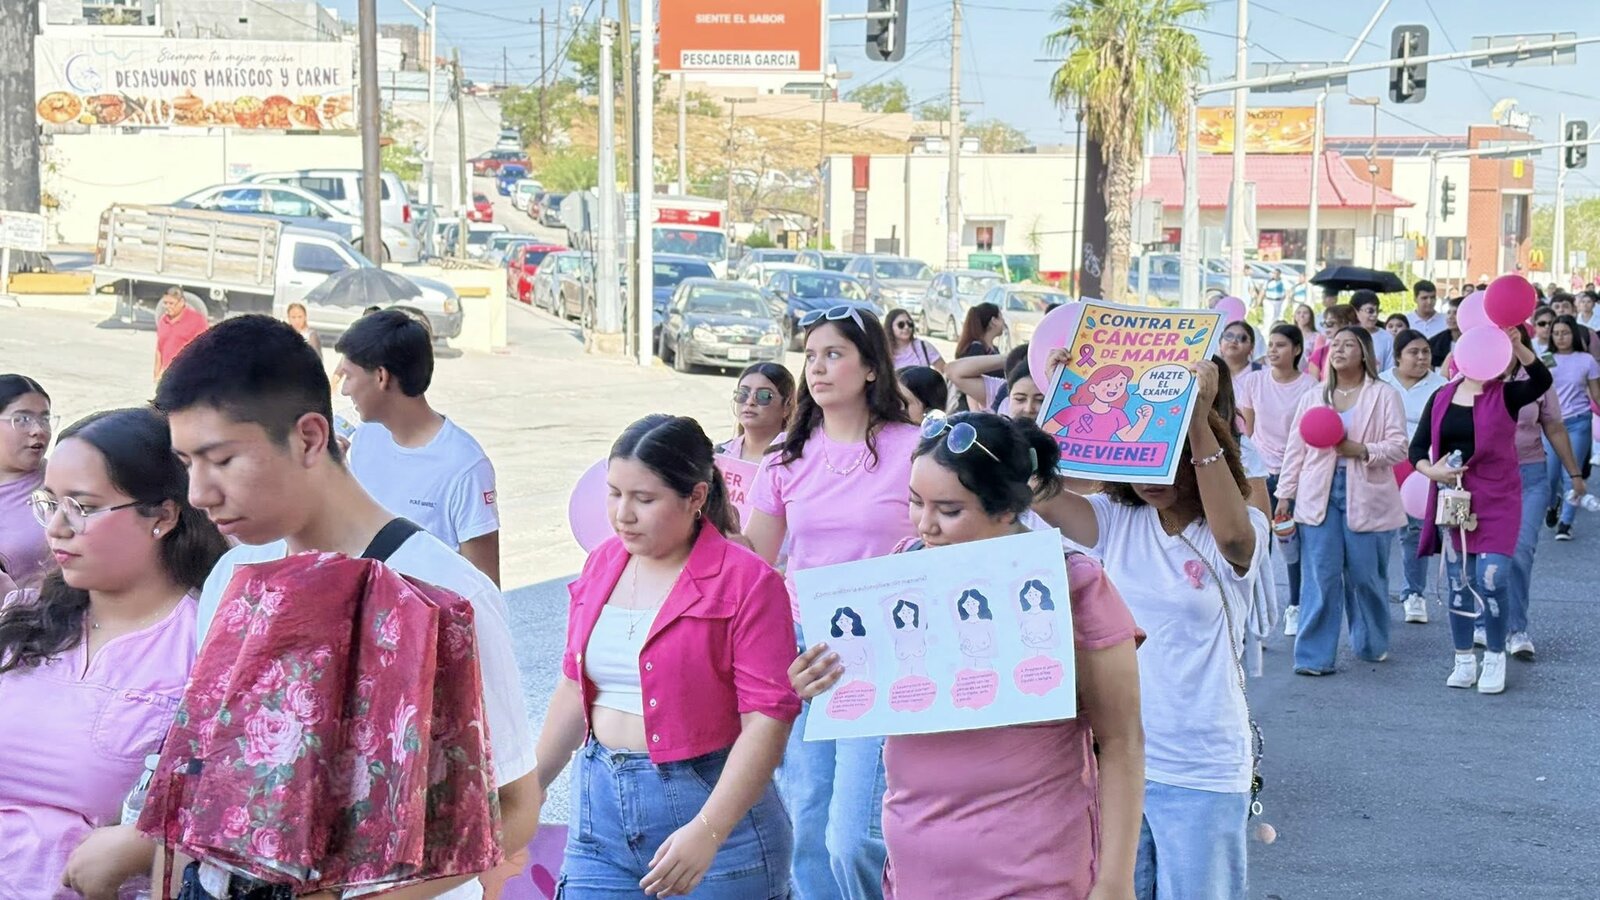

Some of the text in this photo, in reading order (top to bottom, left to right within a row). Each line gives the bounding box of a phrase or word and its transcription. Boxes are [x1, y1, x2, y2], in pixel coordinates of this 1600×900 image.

[696, 14, 785, 24] SIENTE EL SABOR
[157, 47, 204, 63] Siempre
[683, 53, 797, 66] PESCADERIA GARCIA
[115, 68, 197, 88] DESAYUNOS
[280, 68, 290, 87] Y
[296, 67, 341, 87] CARNE
[1100, 313, 1196, 330] CONTRA EL
[1092, 328, 1181, 347] CÁNCER
[1100, 348, 1190, 363] DE MAMA
[1149, 371, 1185, 381] HAZTE
[1142, 387, 1181, 397] EXAMEN
[1158, 380, 1169, 389] EL
[725, 471, 742, 487] ER
